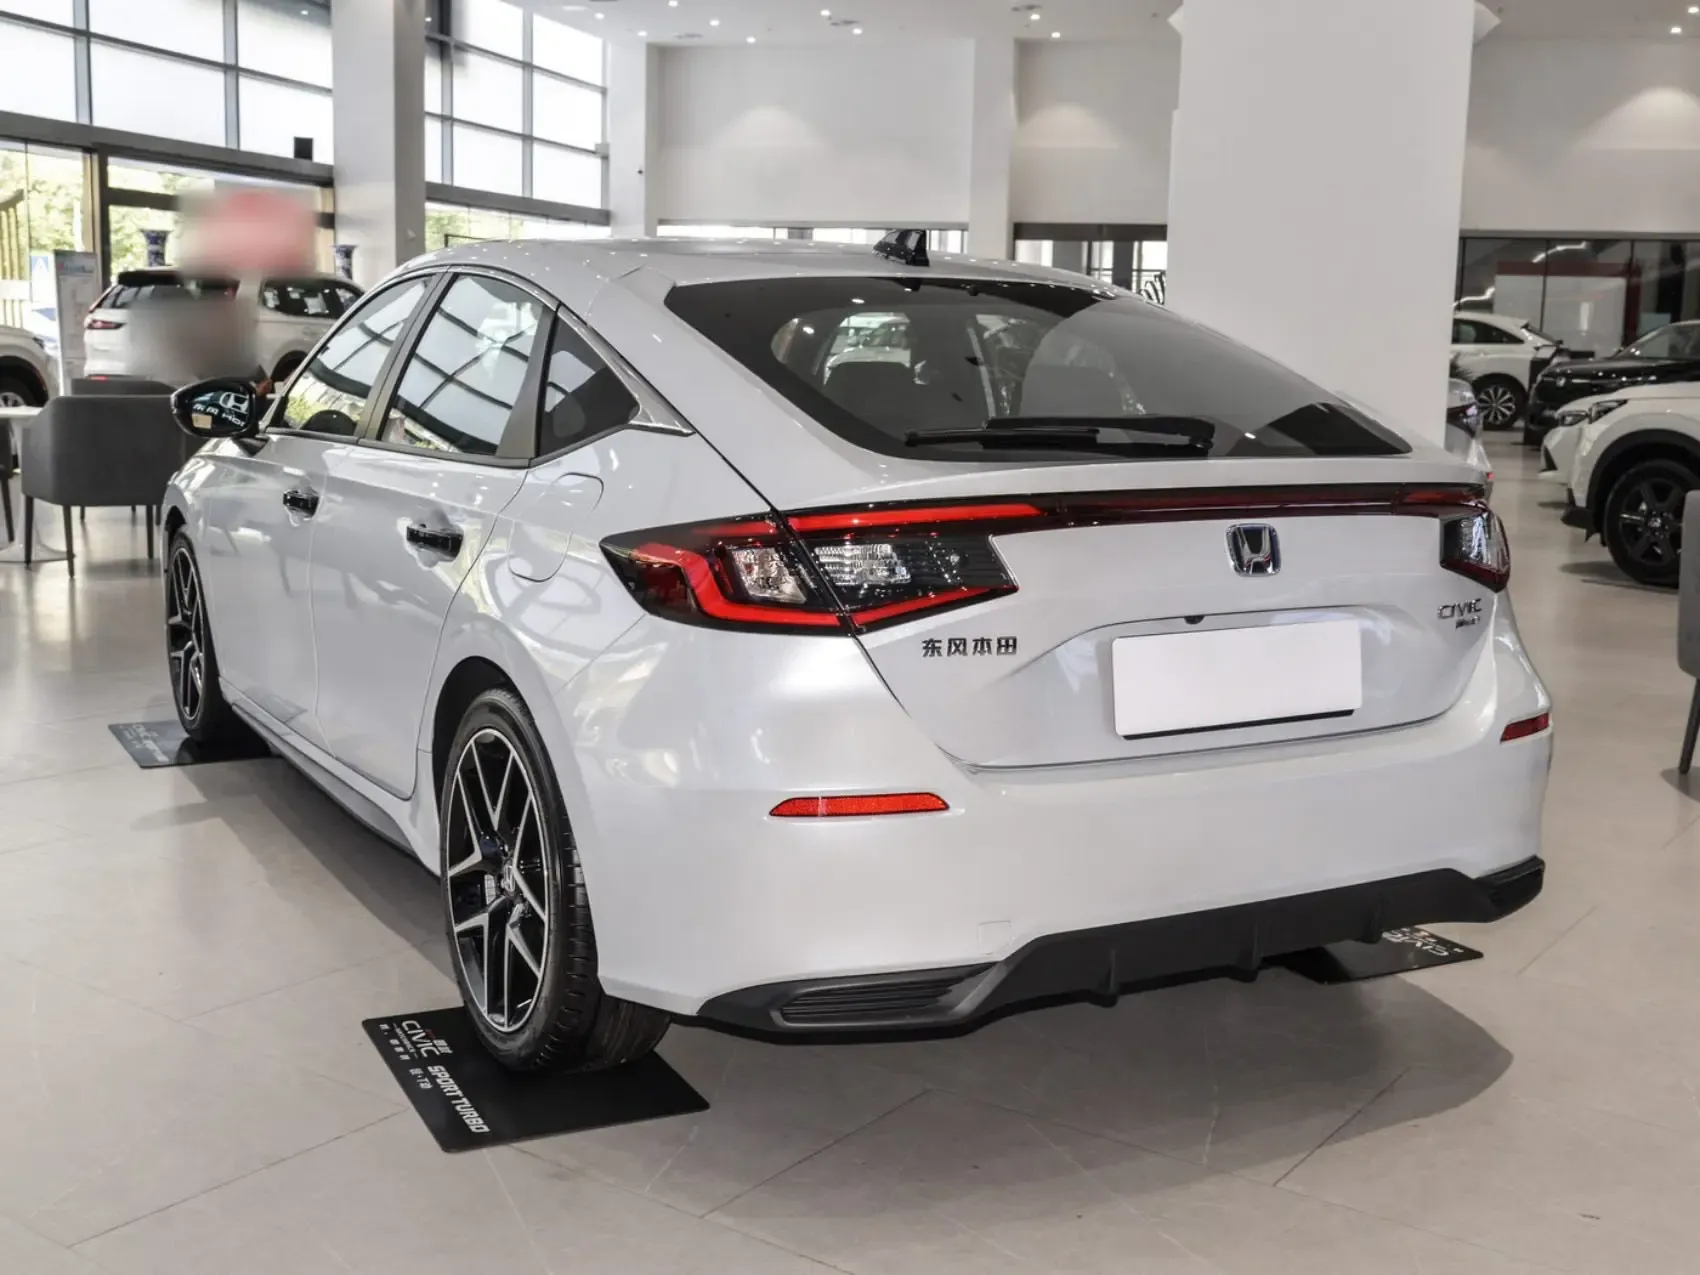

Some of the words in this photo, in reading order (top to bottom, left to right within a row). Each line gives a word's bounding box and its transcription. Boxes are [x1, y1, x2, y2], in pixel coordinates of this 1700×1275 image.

[1438, 598, 1482, 619] CIVIC
[921, 636, 1017, 657] 东风本田
[402, 1020, 440, 1057] CIVIC
[427, 1065, 464, 1096] SPORT
[451, 1097, 490, 1133] TURBO
